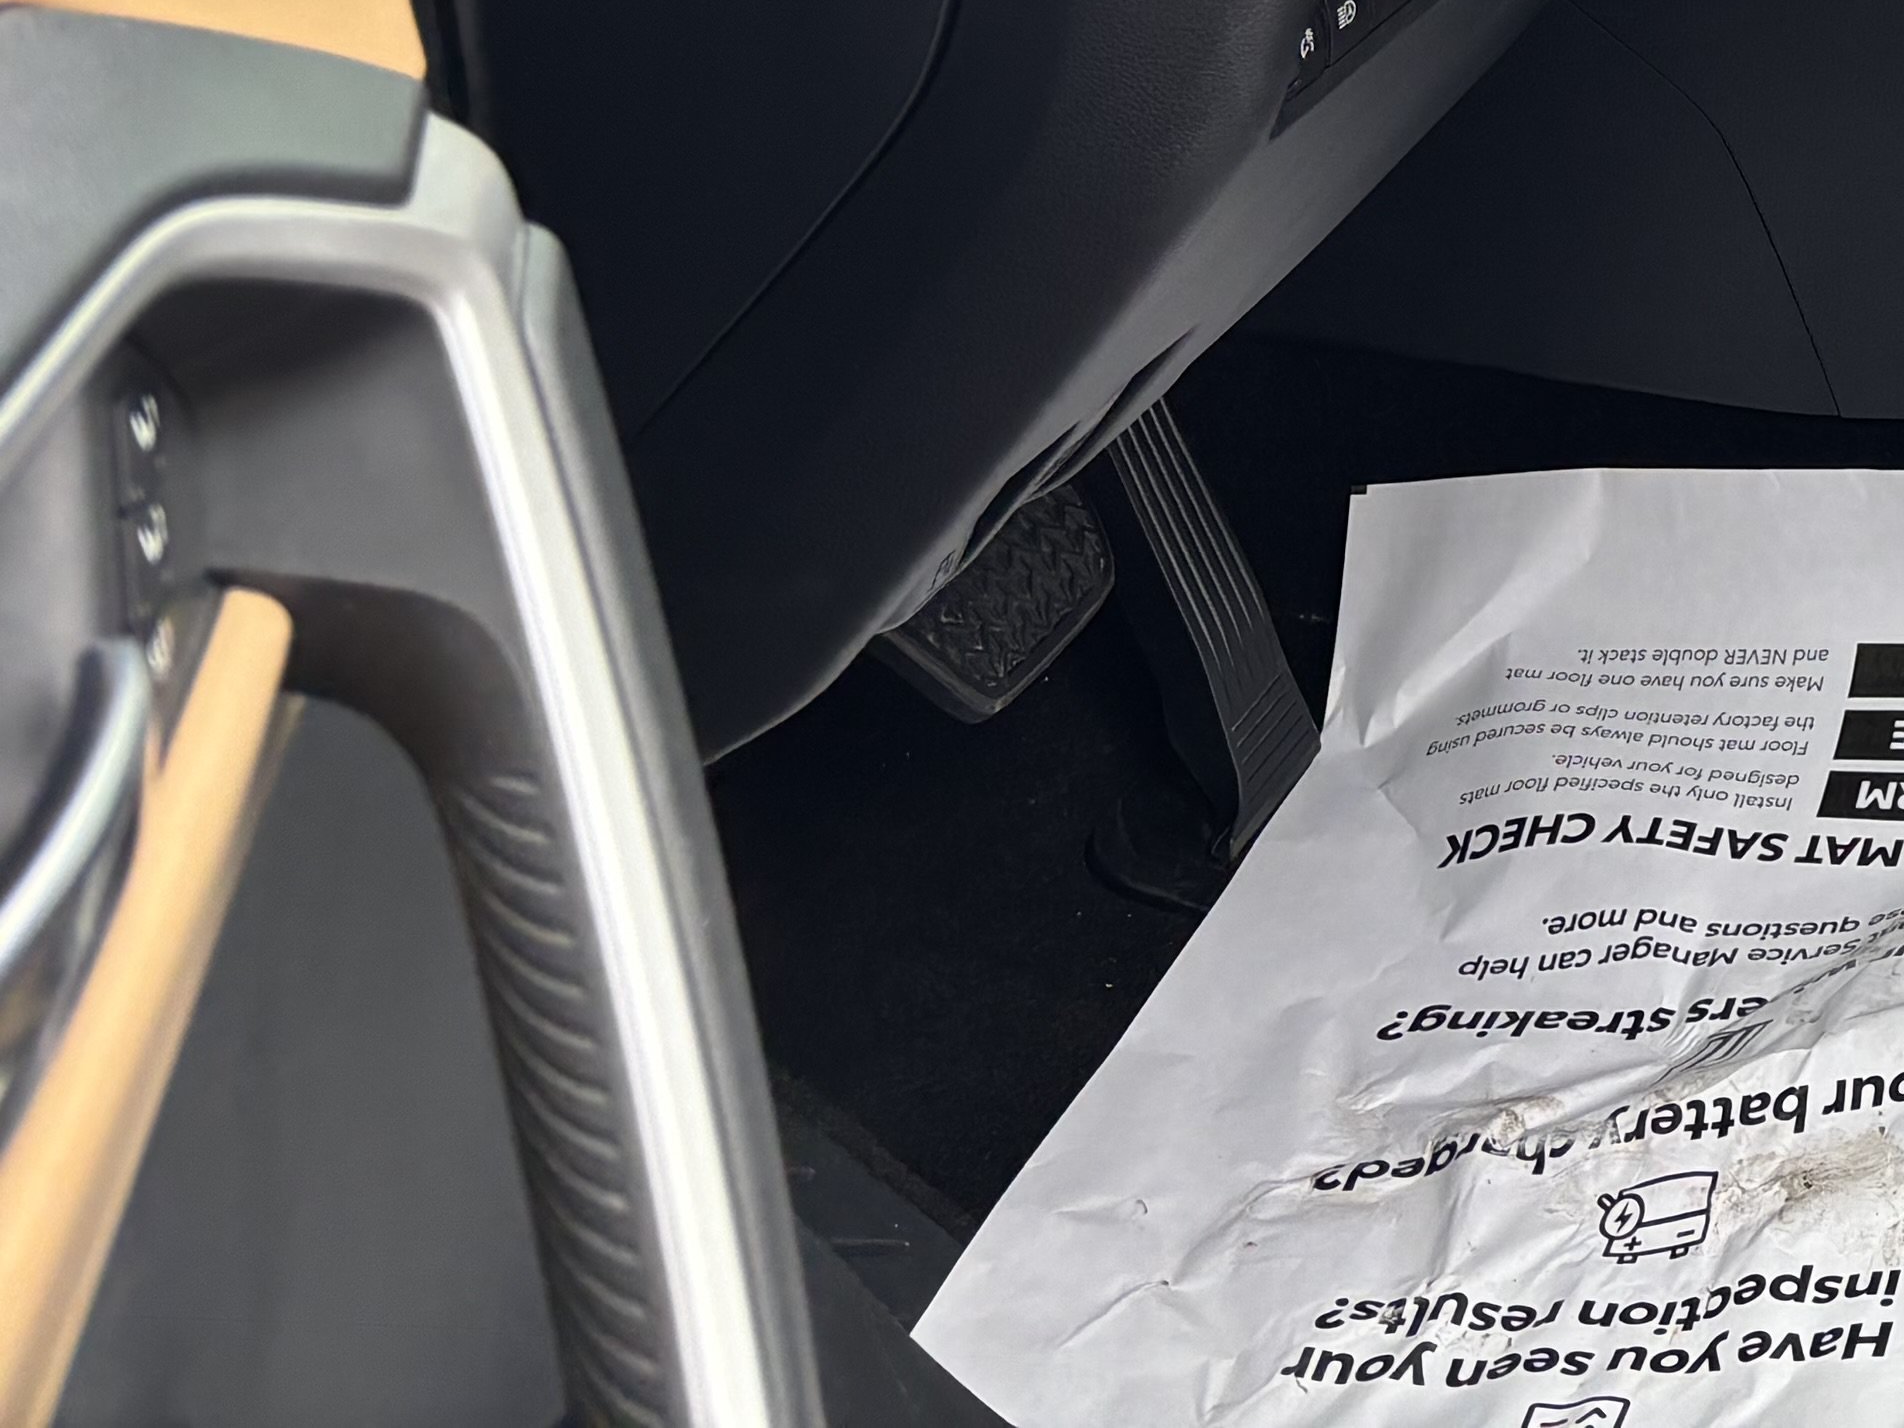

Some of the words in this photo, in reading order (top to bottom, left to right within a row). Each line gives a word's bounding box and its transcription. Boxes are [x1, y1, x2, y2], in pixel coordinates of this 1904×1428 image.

[1576, 648, 1596, 666] it.
[1597, 648, 1649, 666] stack
[1651, 648, 1719, 666] double
[1723, 648, 1789, 665] NEVER
[1792, 648, 1830, 665] and
[1504, 666, 1545, 683] mat
[1546, 670, 1594, 688] floor
[1596, 672, 1636, 687] one
[1639, 674, 1686, 691] have
[1688, 670, 1728, 689] you
[1729, 674, 1771, 689] sure
[1773, 674, 1825, 693] Make
[1454, 697, 1547, 726] grommets.
[1547, 702, 1572, 716] or
[1575, 702, 1620, 722] clips
[1623, 709, 1710, 727] retention
[1549, 722, 1576, 739] be
[1711, 711, 1781, 731] factory
[1783, 715, 1816, 731] the
[1472, 722, 1546, 746] secured
[1580, 724, 1645, 745] always
[1647, 732, 1715, 752] should
[1425, 732, 1472, 758] using
[1717, 738, 1756, 753] mat
[1759, 738, 1810, 756] Floor
[1550, 753, 1623, 772] vehicle.
[1625, 759, 1675, 776] your
[1675, 765, 1704, 782] for
[1708, 767, 1801, 789] designed
[1504, 775, 1550, 793] floor
[1553, 774, 1645, 794] specified
[1648, 782, 1682, 798] the
[1686, 784, 1729, 802] only
[1458, 782, 1501, 807] mats
[1733, 793, 1794, 812] Install
[1436, 812, 1596, 869] CHECK
[1600, 814, 1789, 863] SAFETY
[1794, 834, 1904, 867] MAT
[1541, 908, 1628, 938] more.
[1633, 908, 1698, 936] and
[1704, 916, 1860, 941] questions
[1538, 948, 1593, 973] can
[1598, 936, 1739, 968] Manager
[1747, 938, 1861, 966] Service
[1458, 954, 1530, 982] help
[1377, 1004, 1676, 1041] streaking?
[1588, 1085, 1808, 1148] battery
[1578, 1265, 1902, 1337] inspection
[1313, 1291, 1564, 1339] results?
[1737, 1321, 1893, 1366] Have
[1280, 1340, 1437, 1387] your
[1606, 1332, 1729, 1378] you
[1445, 1349, 1596, 1390] seen
